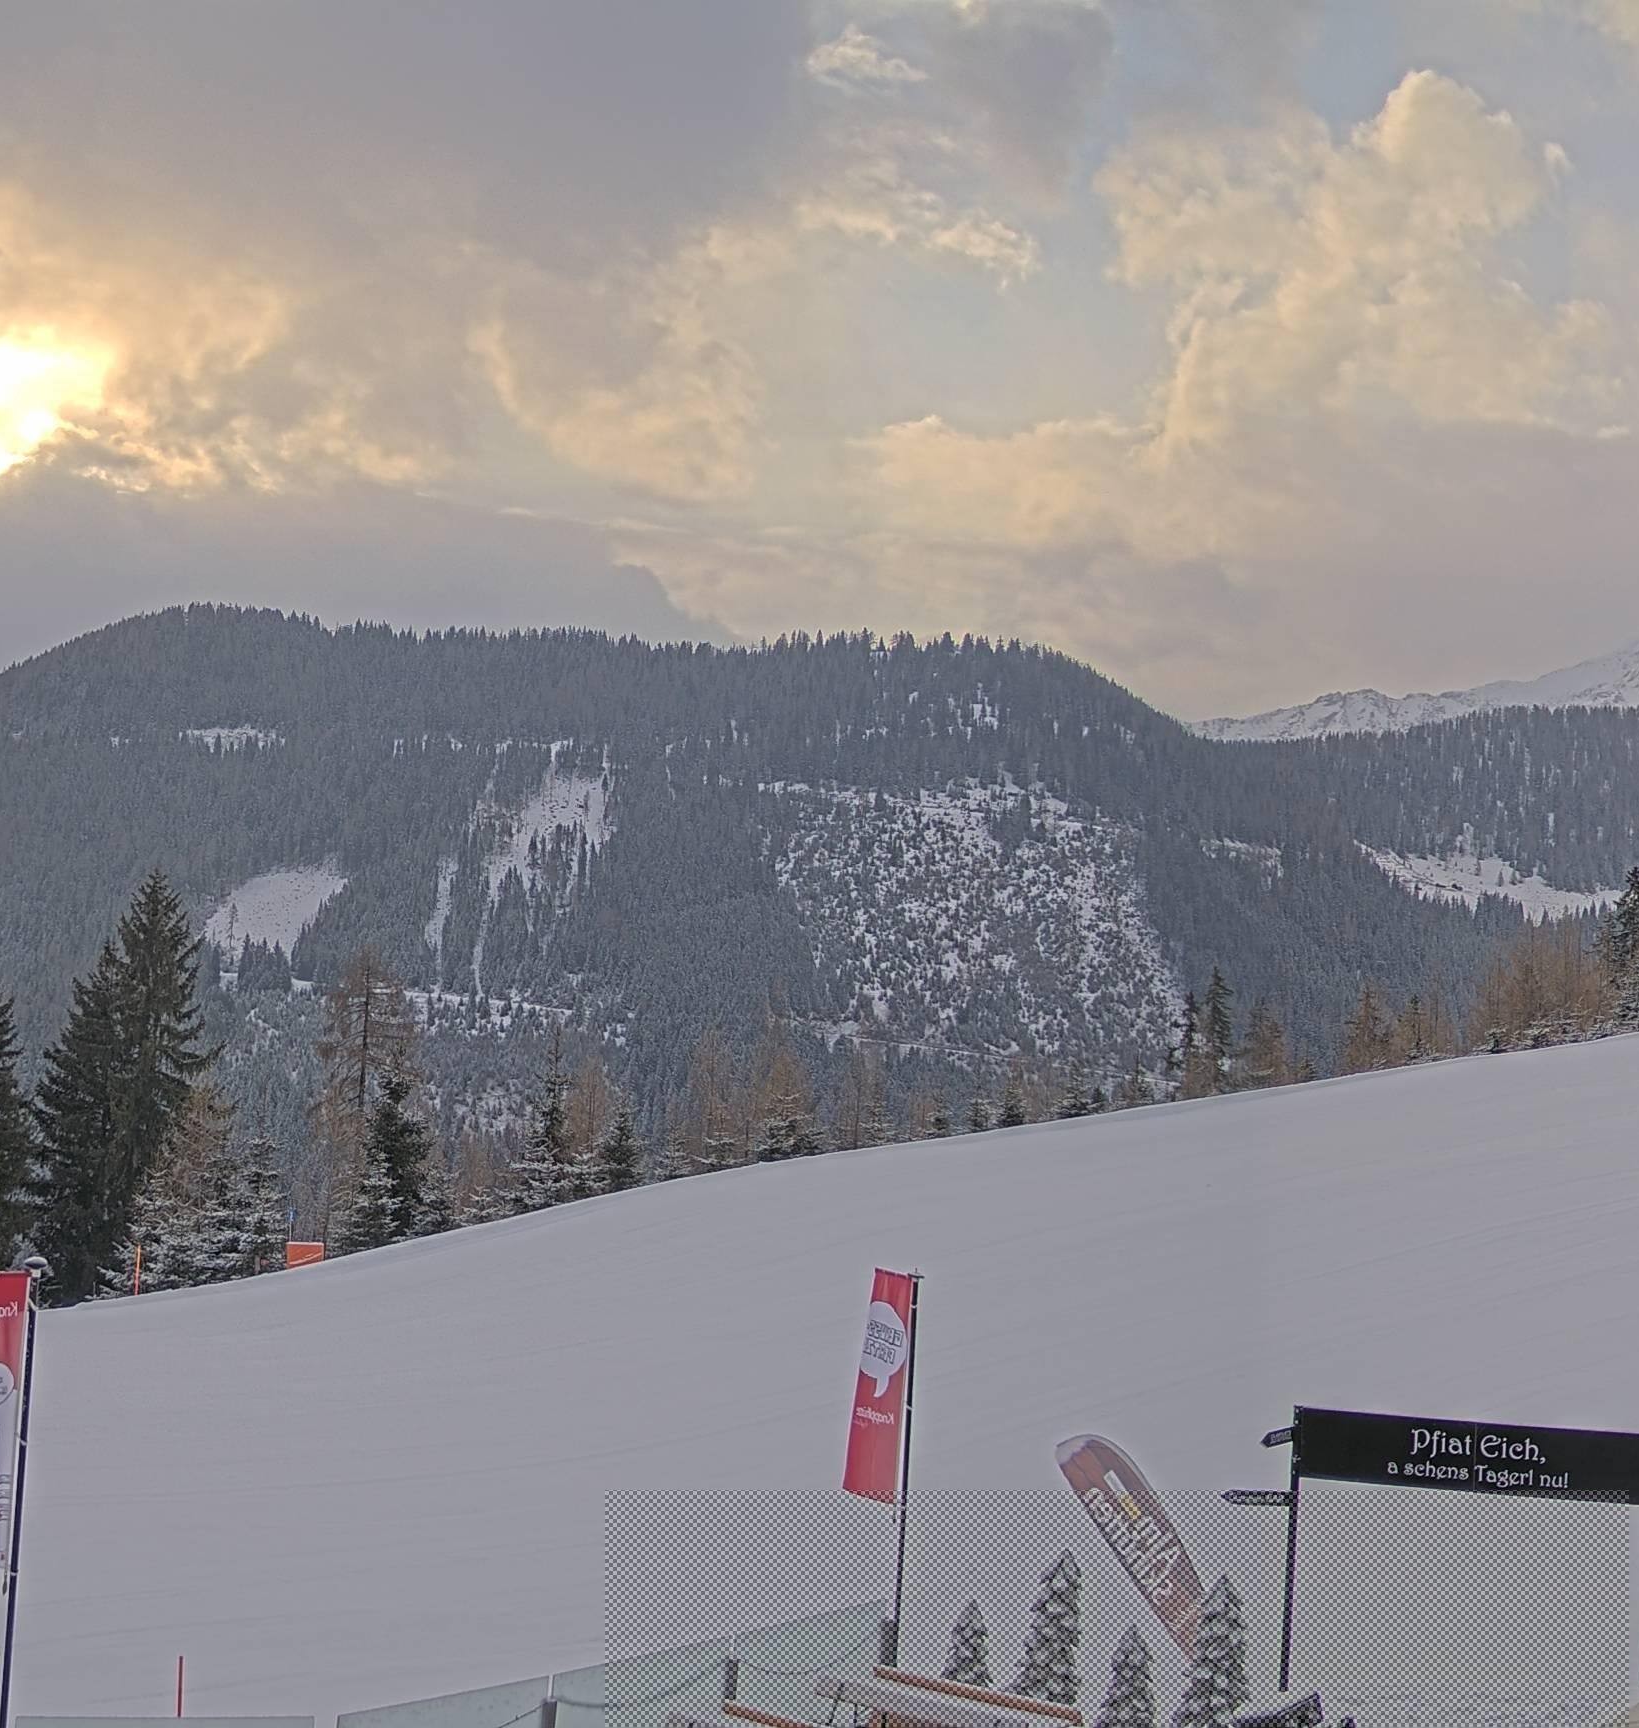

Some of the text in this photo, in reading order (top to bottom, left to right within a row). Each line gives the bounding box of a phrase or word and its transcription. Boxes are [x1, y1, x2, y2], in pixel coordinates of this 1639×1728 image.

[1410, 1427, 1547, 1465] Pfiat Eich,
[1387, 1461, 1569, 1489] a schens Tagerl nu!
